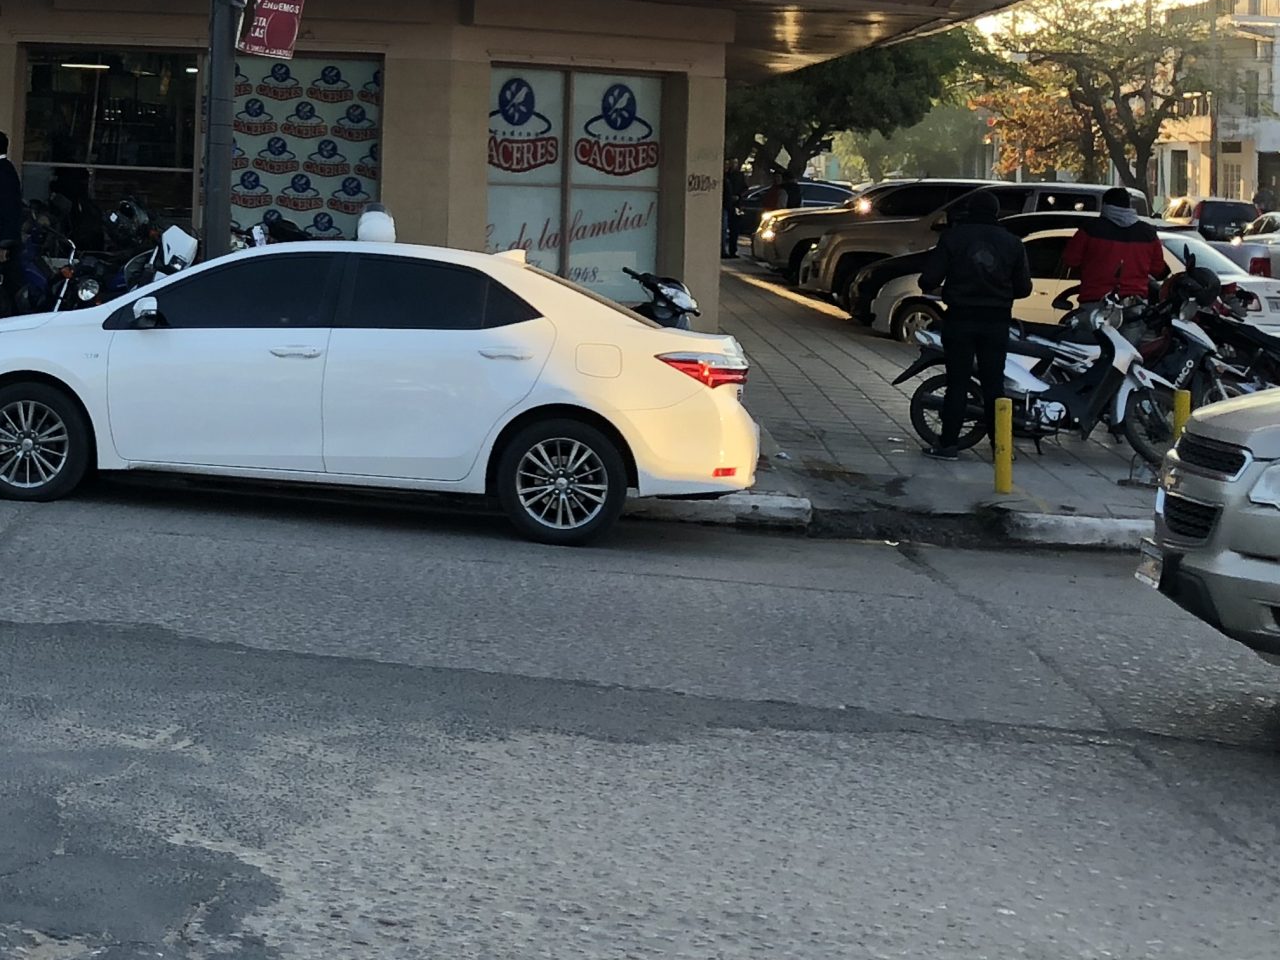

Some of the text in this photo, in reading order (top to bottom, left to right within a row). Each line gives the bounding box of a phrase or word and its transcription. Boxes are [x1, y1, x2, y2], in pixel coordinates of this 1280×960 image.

[488, 140, 557, 169] ACERES
[576, 141, 657, 172] CACERES
[1173, 359, 1194, 387] YMCO
